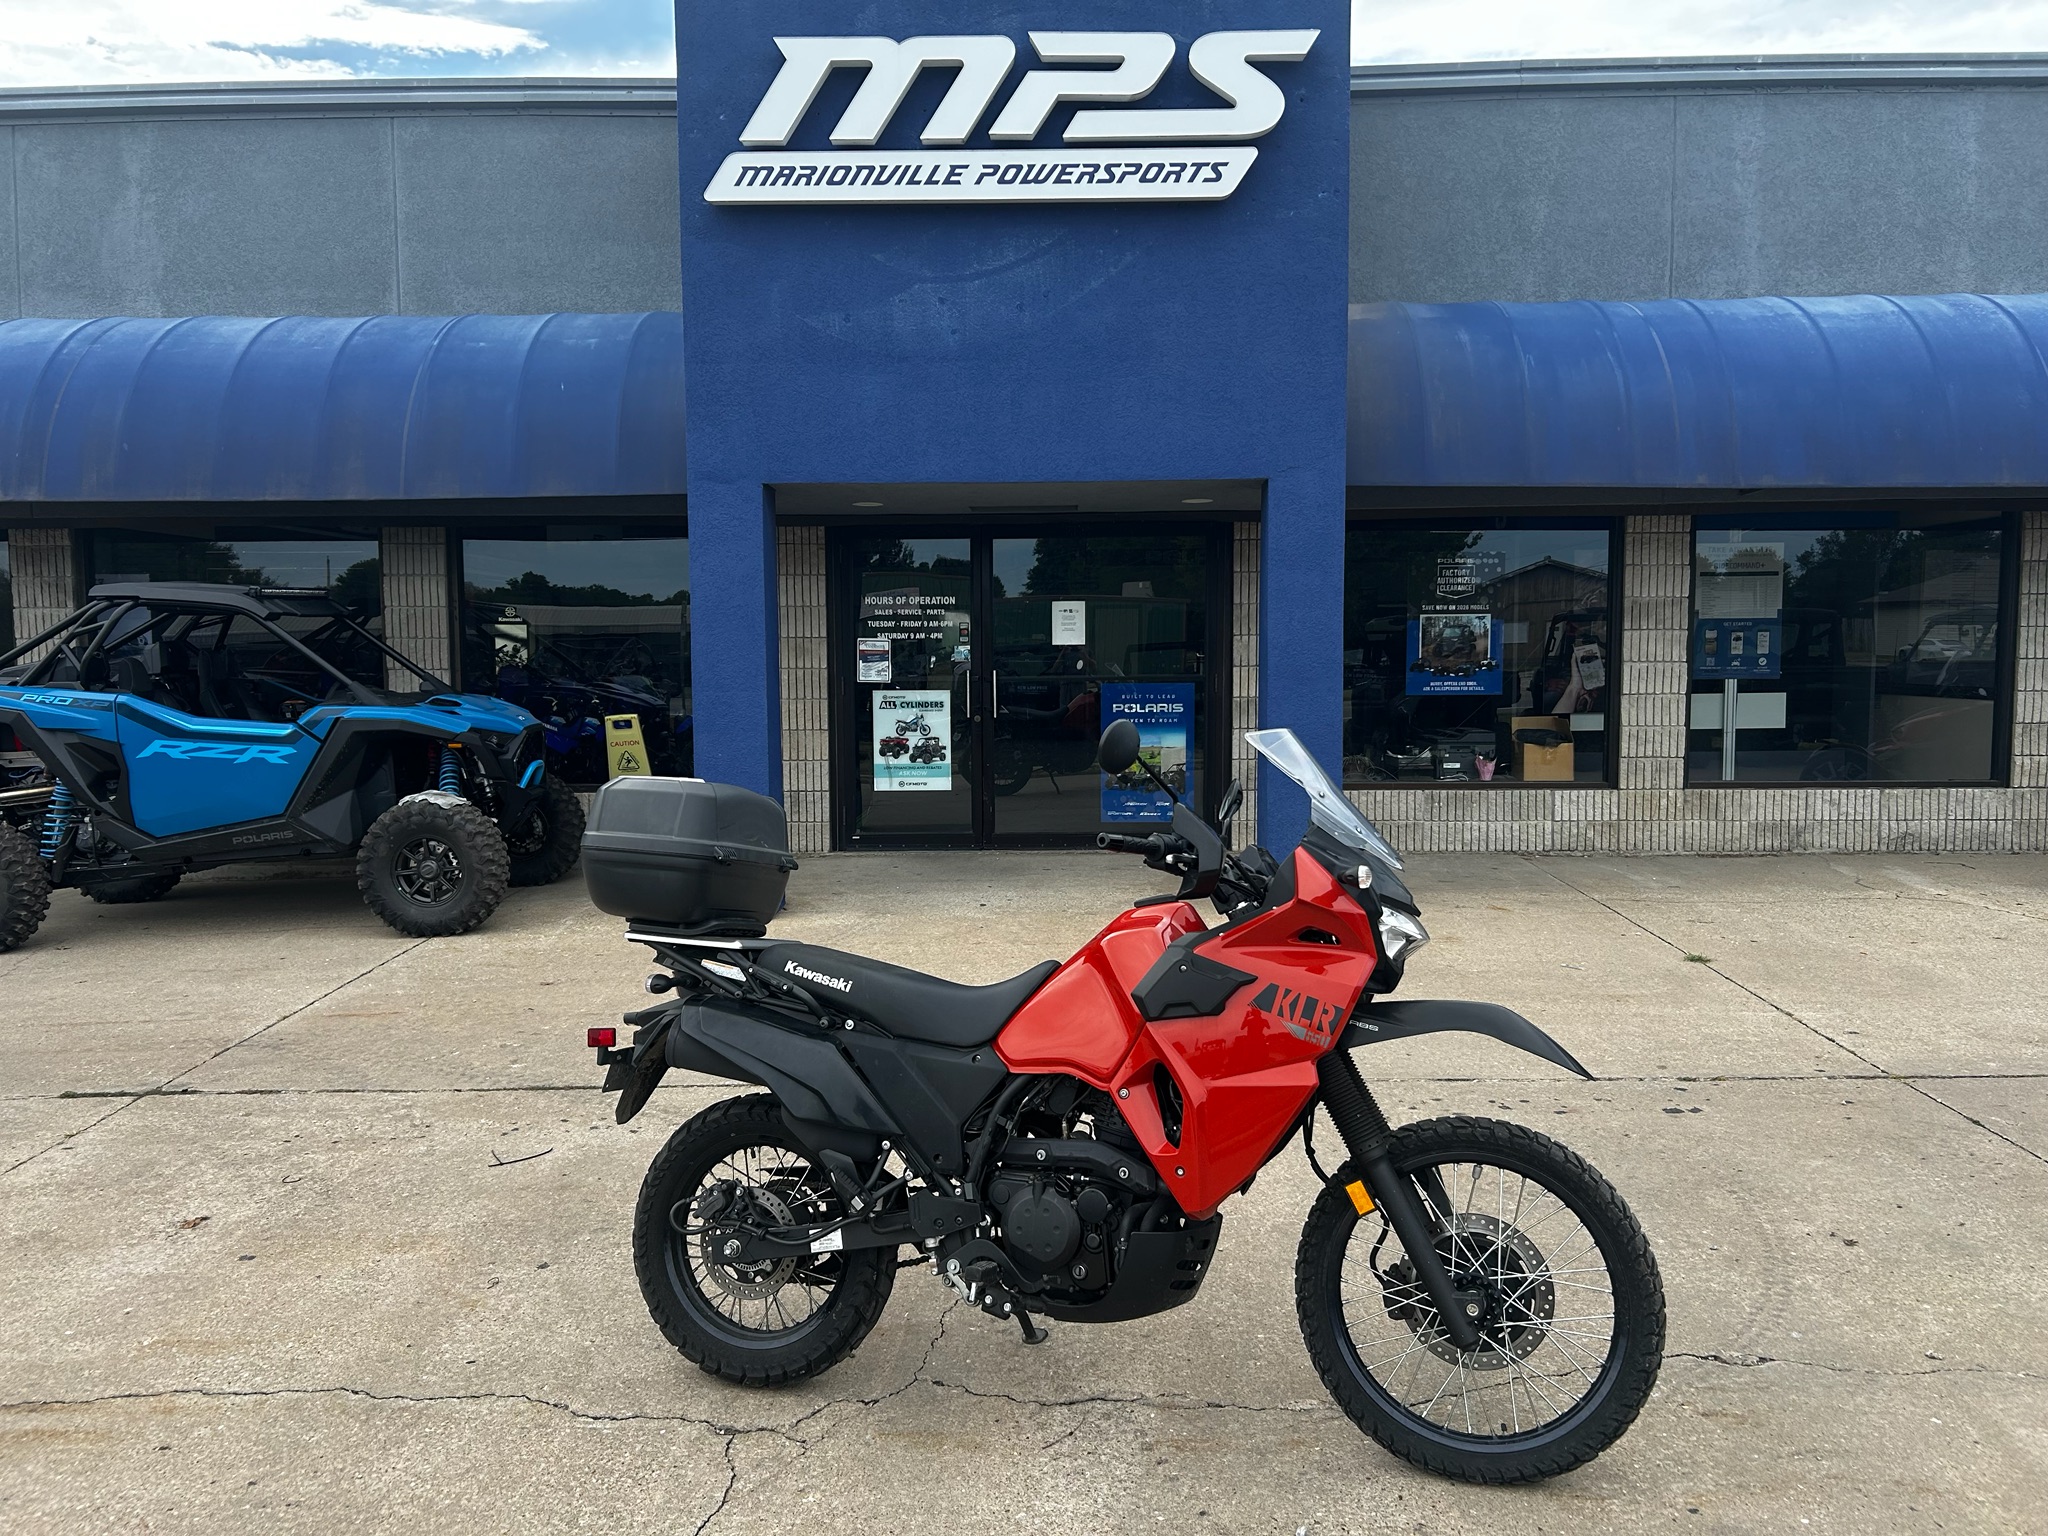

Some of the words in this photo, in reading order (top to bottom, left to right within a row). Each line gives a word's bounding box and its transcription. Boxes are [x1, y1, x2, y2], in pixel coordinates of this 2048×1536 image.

[738, 28, 1322, 145] MPS
[734, 163, 970, 187] MARIONVILLE
[973, 161, 1230, 186] POWERSPORTS
[1442, 569, 1471, 577] FACTORY
[864, 596, 893, 605] HOURS
[896, 596, 907, 605] OF
[908, 596, 956, 605] OPERATION
[874, 608, 893, 616] SALES
[897, 608, 922, 616] SERVICE
[926, 608, 946, 616] PARTS
[867, 620, 896, 628] TUESDAY
[900, 620, 922, 628] FRIDAY
[923, 620, 928, 628] 9
[877, 632, 909, 640] SATURDAY
[909, 632, 914, 640] 9
[915, 632, 925, 640] AM
[19, 693, 73, 706] PRO
[880, 701, 896, 709] ALL
[900, 701, 944, 709] CYLINDERS
[1112, 703, 1184, 713] POLARIS
[609, 739, 640, 748] CAUTION
[135, 739, 298, 765] RZR
[232, 829, 294, 846] POLARIS
[784, 960, 854, 993] Kawasaki
[1271, 985, 1334, 1036] KLR
[1348, 1019, 1380, 1032] ABS
